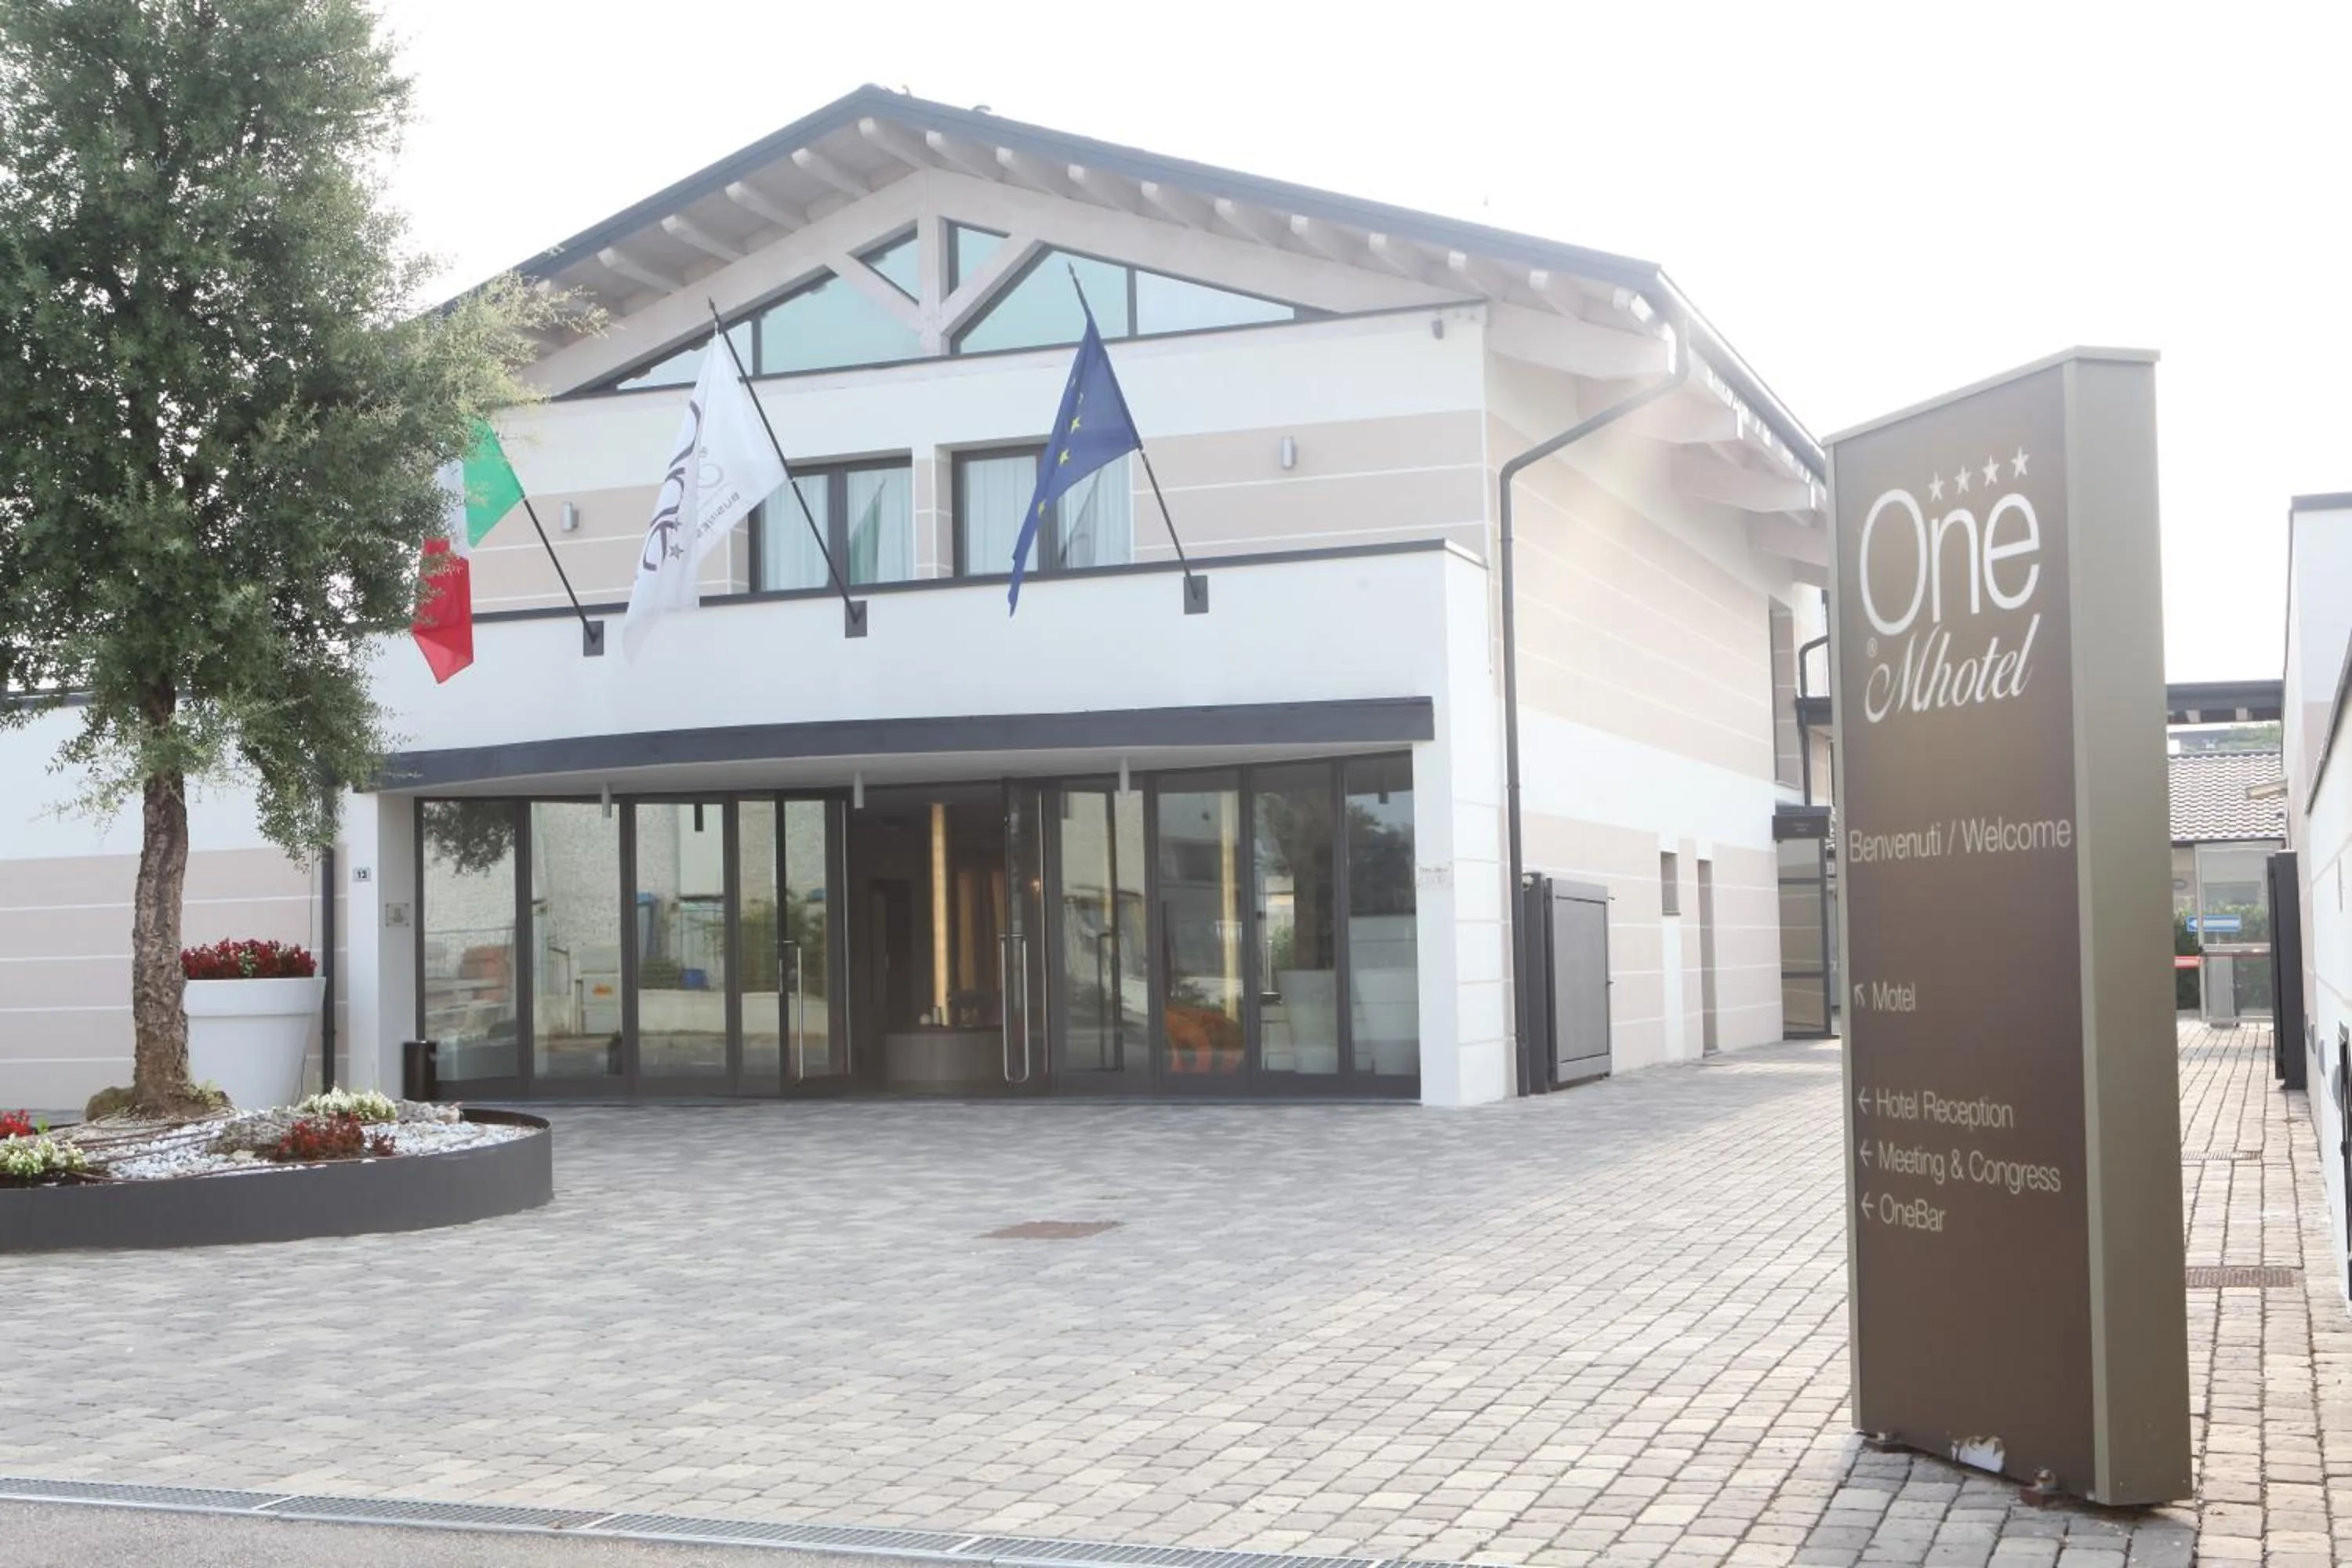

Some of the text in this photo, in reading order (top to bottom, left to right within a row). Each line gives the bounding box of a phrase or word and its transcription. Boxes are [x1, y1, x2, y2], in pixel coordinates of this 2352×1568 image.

[1859, 488, 2040, 636] One
[1849, 822, 1943, 862] Benvenuti
[1961, 815, 2072, 854] Welcome
[1872, 982, 1916, 1012] Motel
[1875, 1087, 2014, 1133] Hotel Reception
[1878, 1141, 2062, 1195] Meeting & Congress
[1879, 1193, 1945, 1232] OneBar
